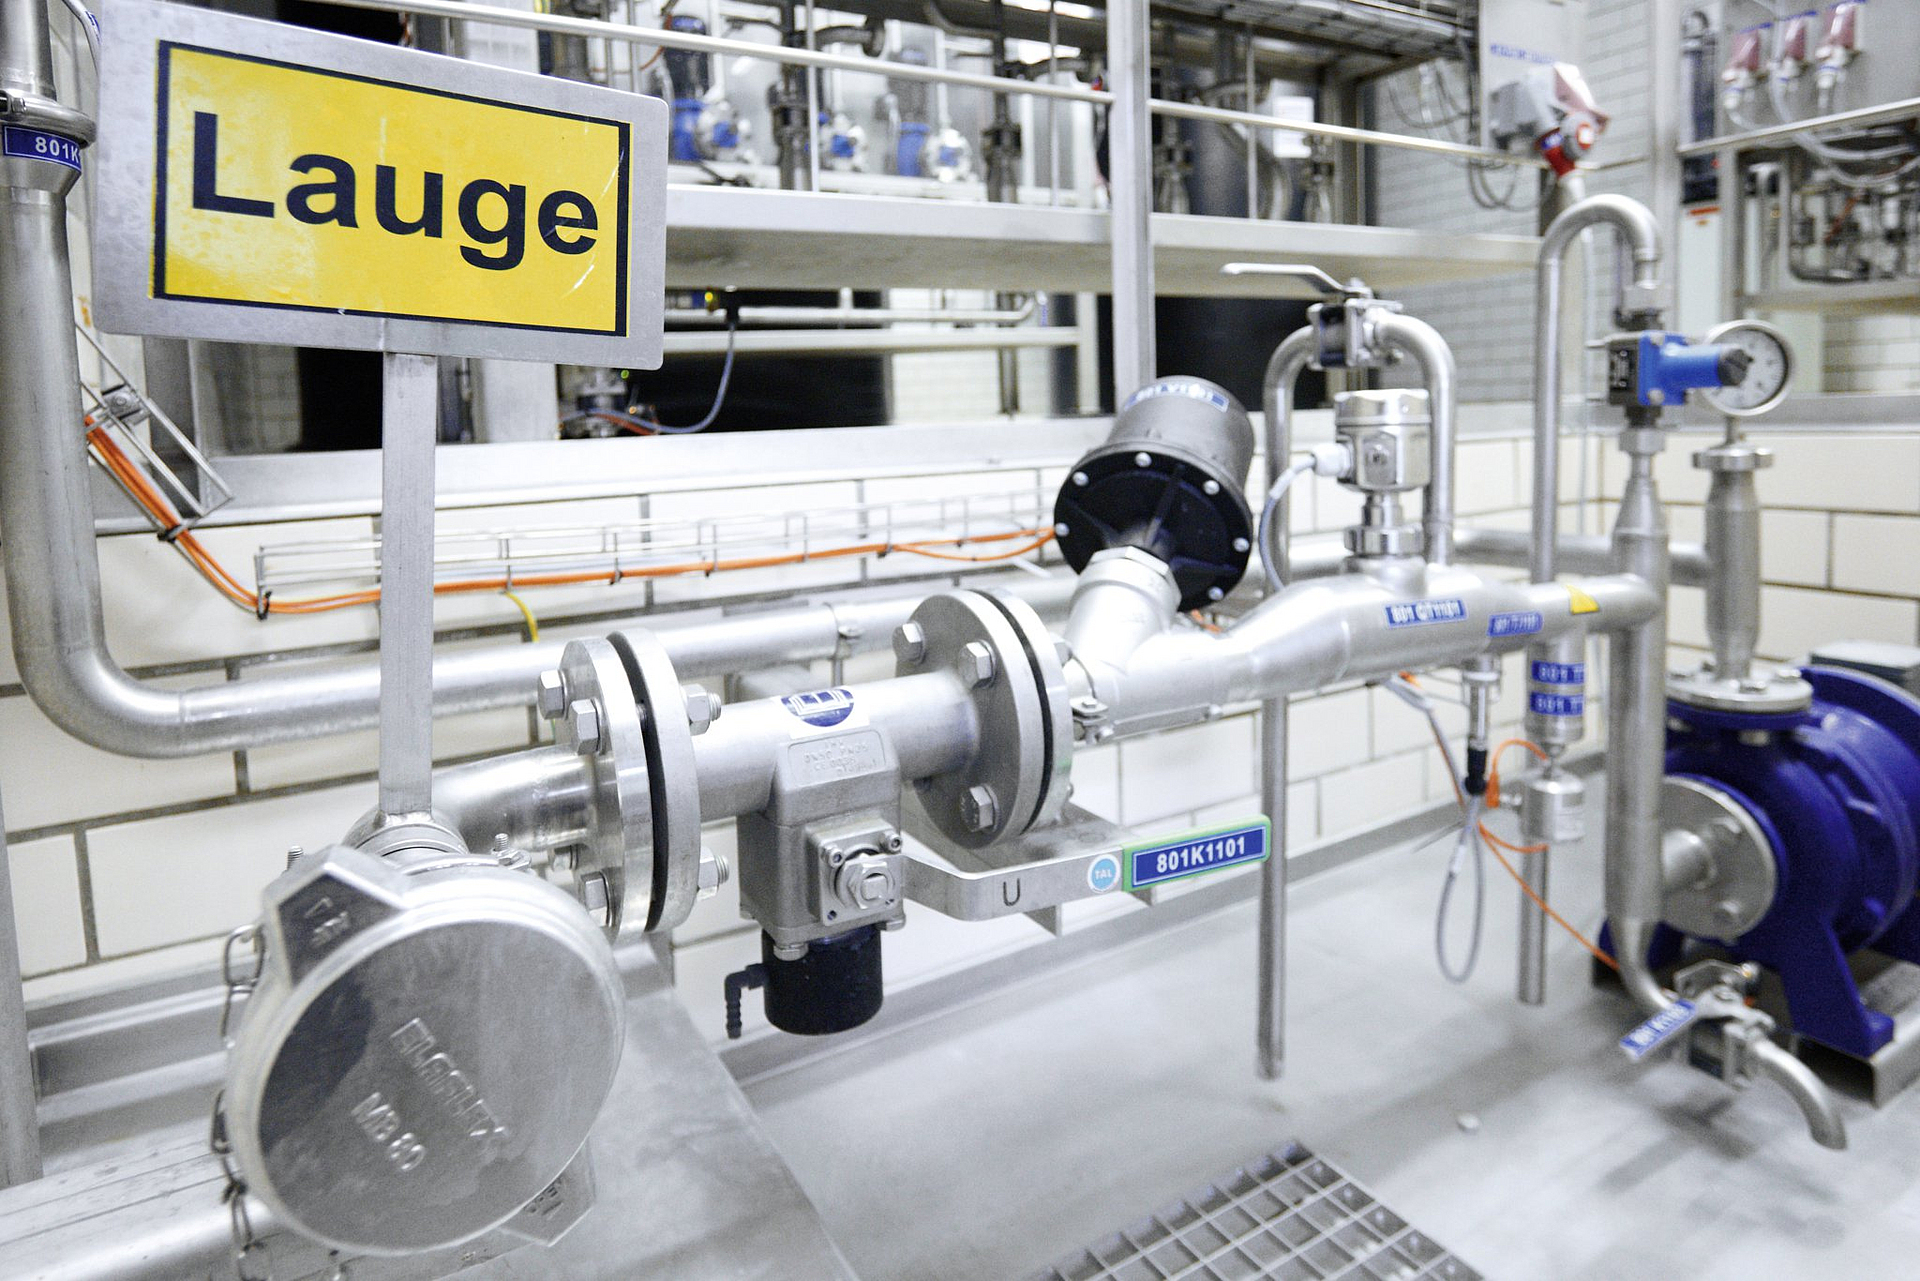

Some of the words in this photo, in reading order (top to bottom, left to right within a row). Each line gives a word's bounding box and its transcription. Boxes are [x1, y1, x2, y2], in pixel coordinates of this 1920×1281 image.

[193, 111, 599, 271] Lauge
[1156, 836, 1246, 873] 801K1101
[1094, 867, 1113, 880] TAL
[1003, 878, 1020, 907] U
